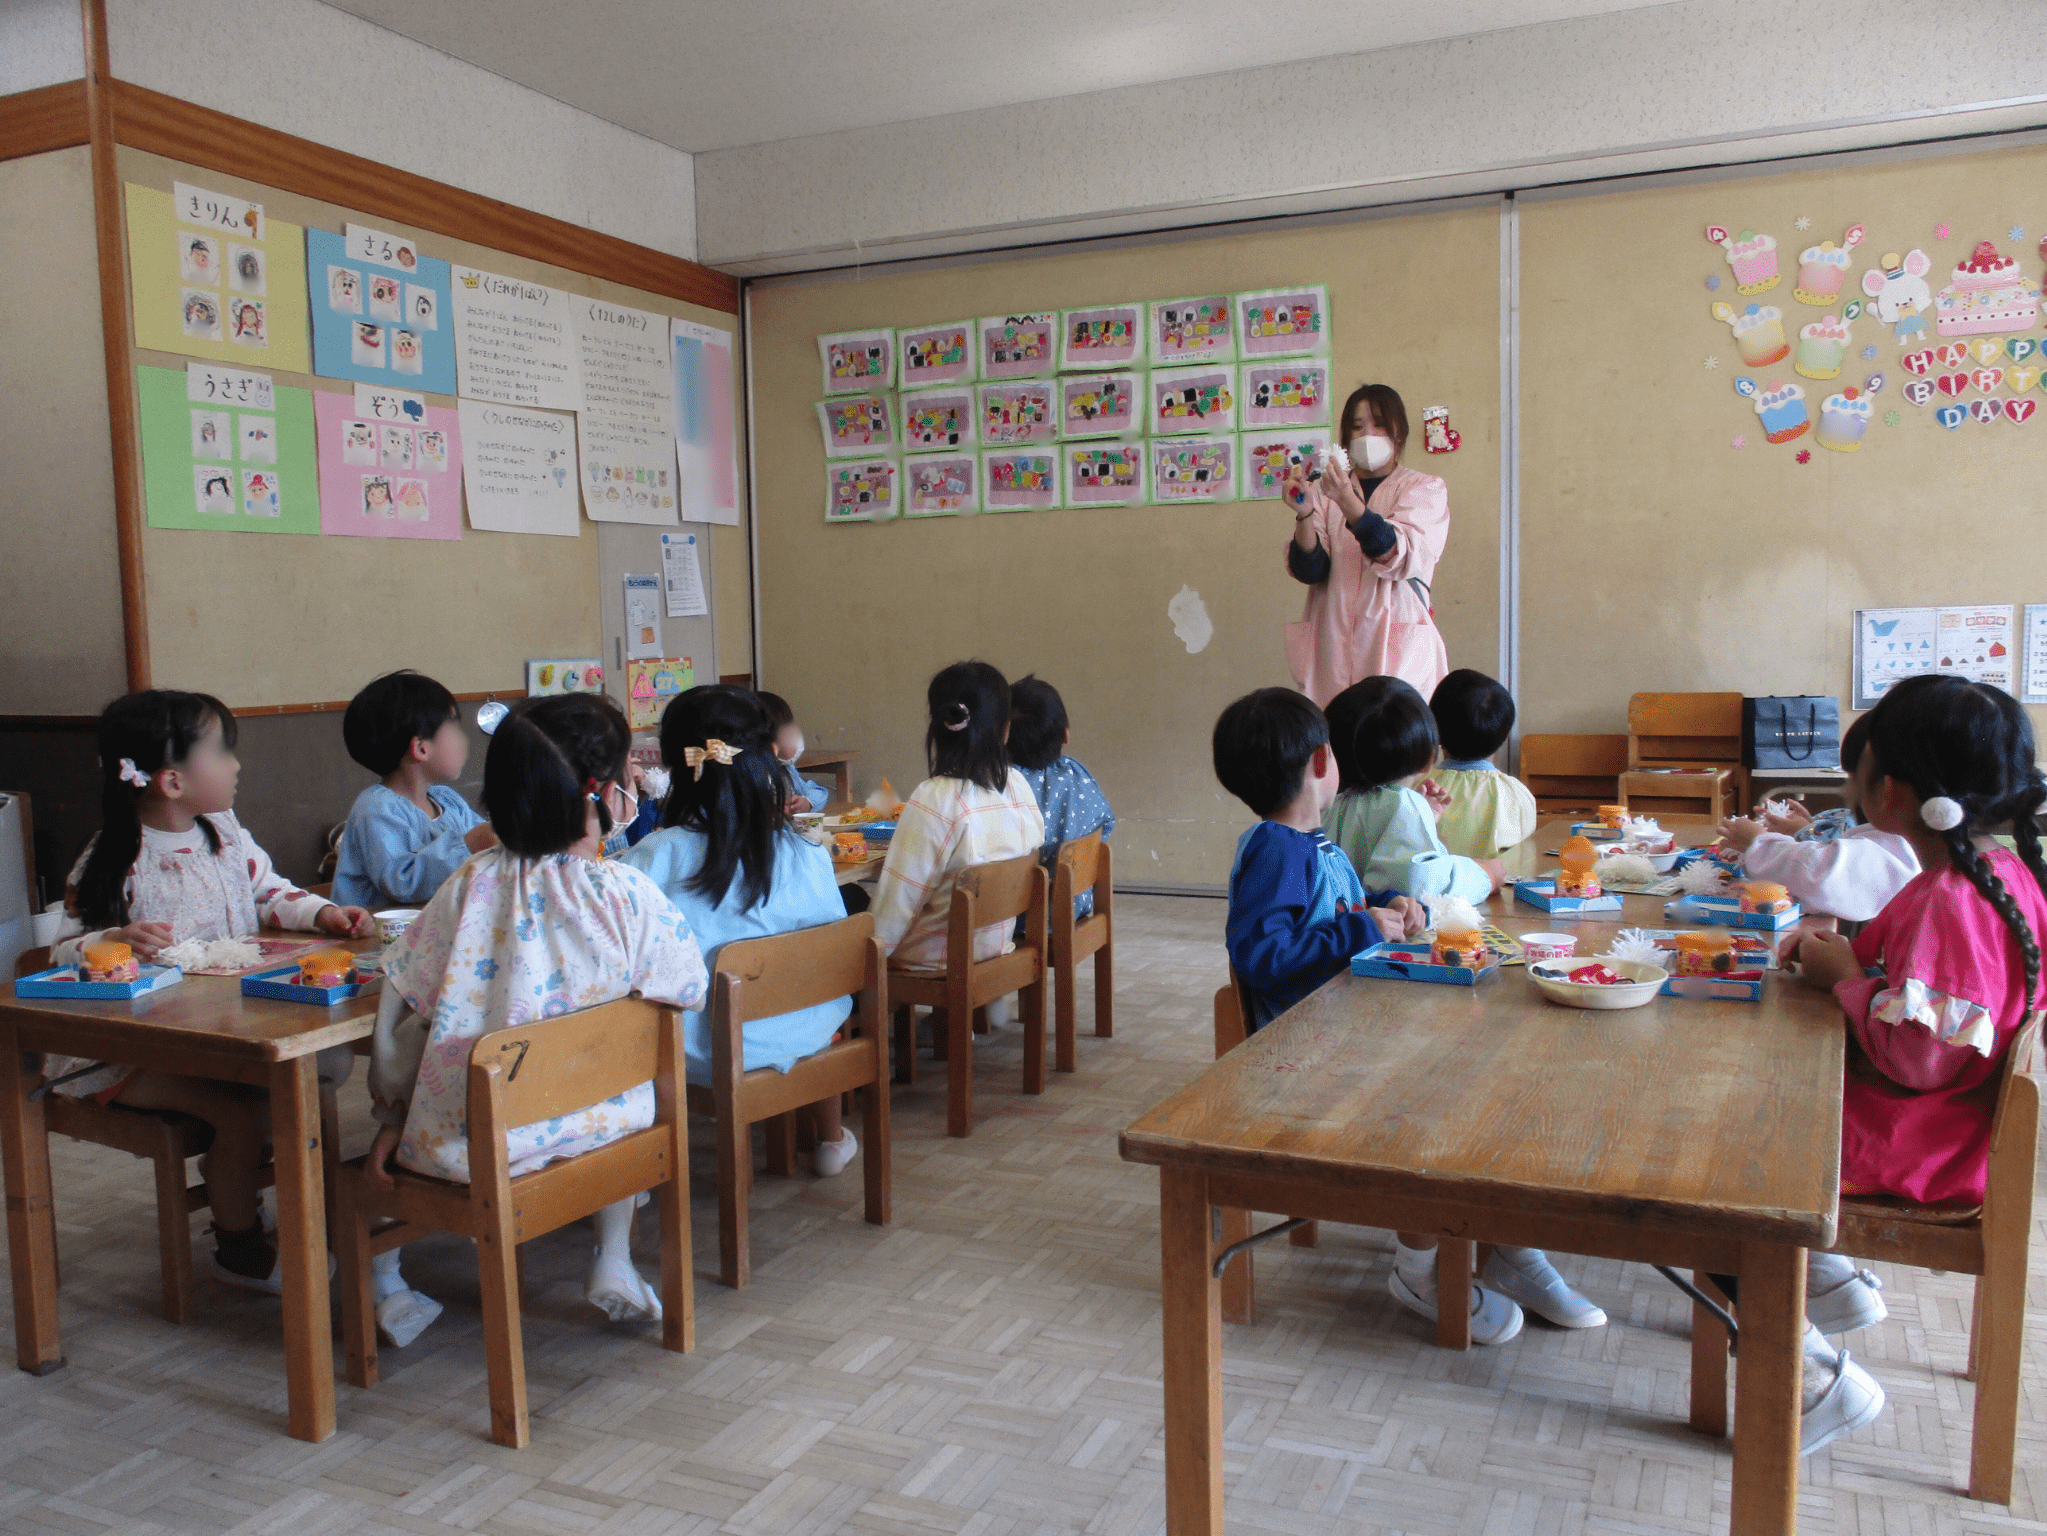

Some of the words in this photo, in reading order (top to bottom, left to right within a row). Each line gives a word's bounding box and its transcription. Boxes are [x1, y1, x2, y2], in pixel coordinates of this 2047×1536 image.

[189, 196, 238, 228] きりん
[364, 235, 393, 261] さる
[1910, 341, 2030, 374] HAPP
[205, 373, 253, 402] うさぎ
[1740, 381, 1754, 394] 8
[1869, 377, 1881, 391] 9
[1913, 371, 2031, 403] BIRT
[371, 396, 399, 418] ぞう
[1944, 401, 2030, 428] DAY
[501, 1040, 530, 1082] 7
